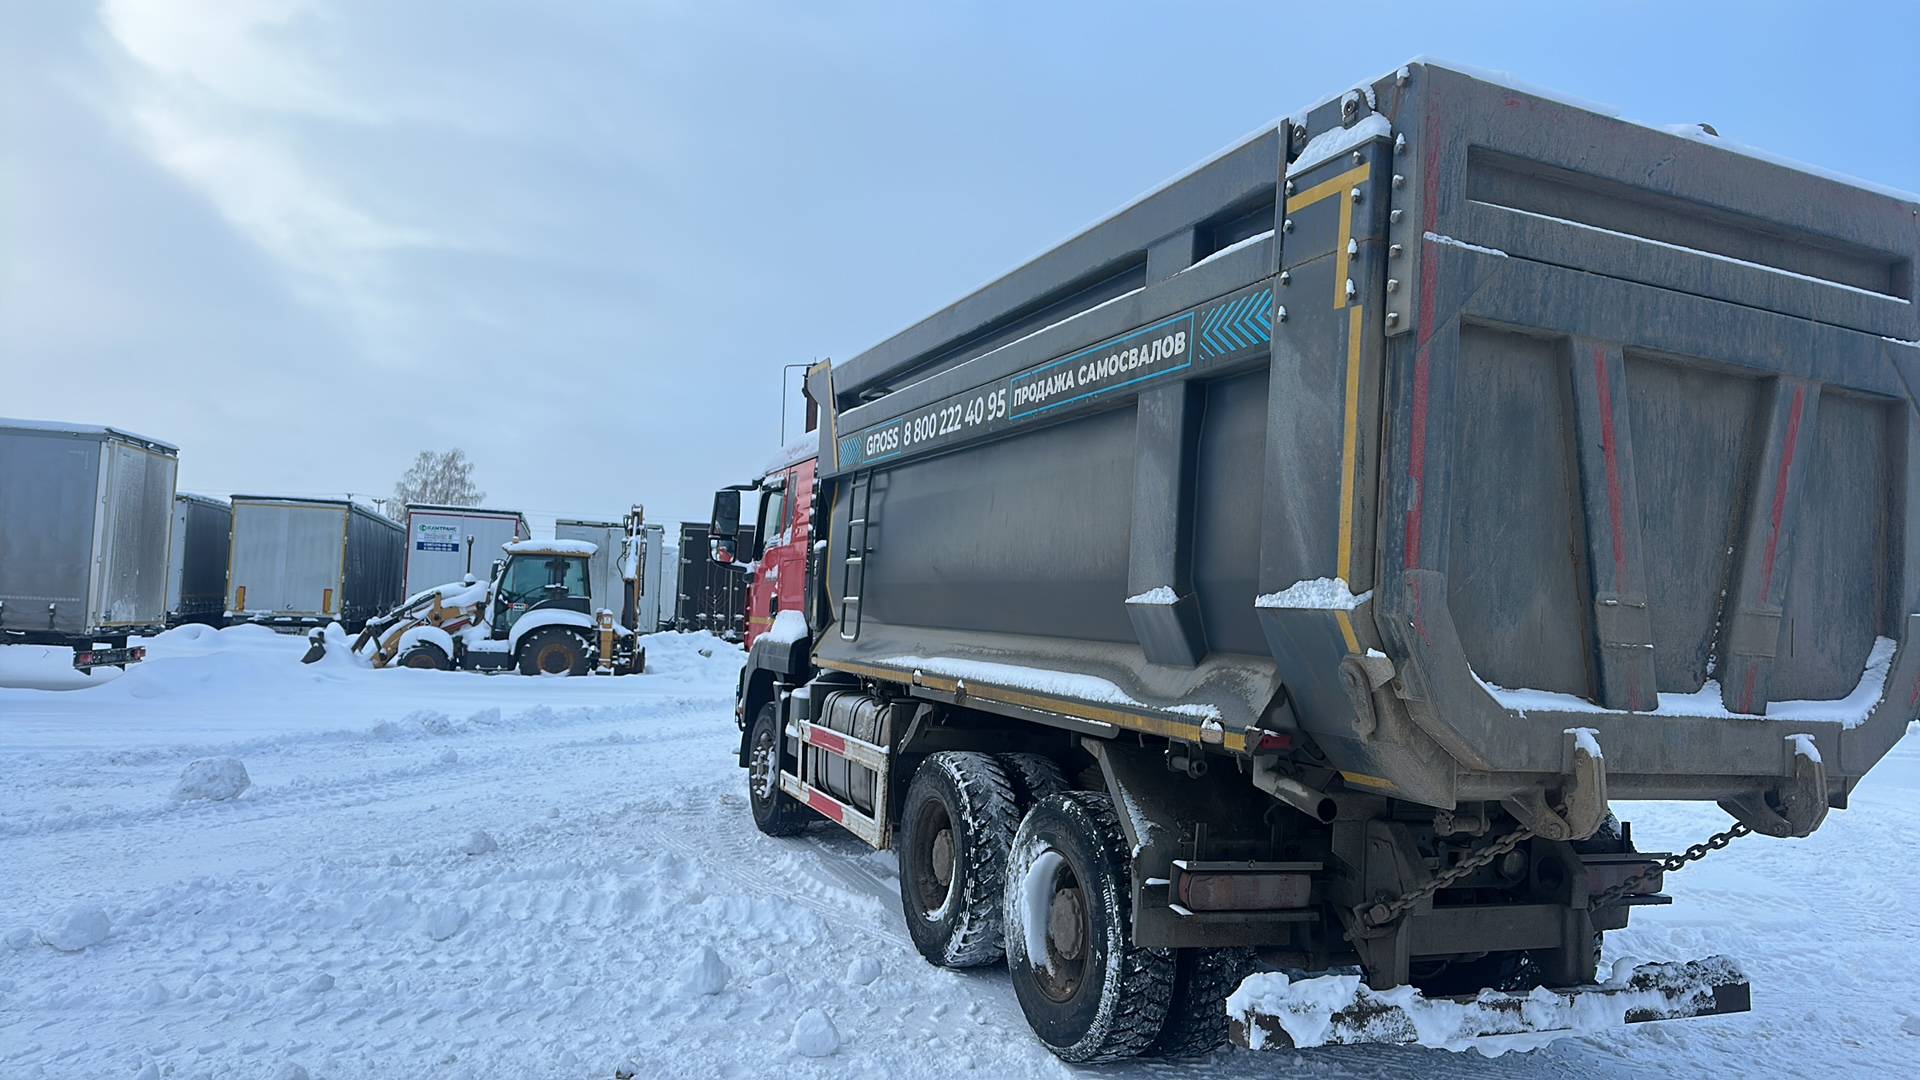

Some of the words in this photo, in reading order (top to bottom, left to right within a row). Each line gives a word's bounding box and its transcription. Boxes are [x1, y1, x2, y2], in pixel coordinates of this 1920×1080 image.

[1014, 370, 1075, 407] ПРОДАЖА
[1077, 332, 1186, 386] САМОСВАЛОВ
[866, 426, 899, 456] GROSS
[903, 421, 911, 446] 8
[913, 413, 937, 443] 800
[939, 404, 962, 435] 222
[964, 396, 984, 426] 40
[987, 388, 1007, 421] 95
